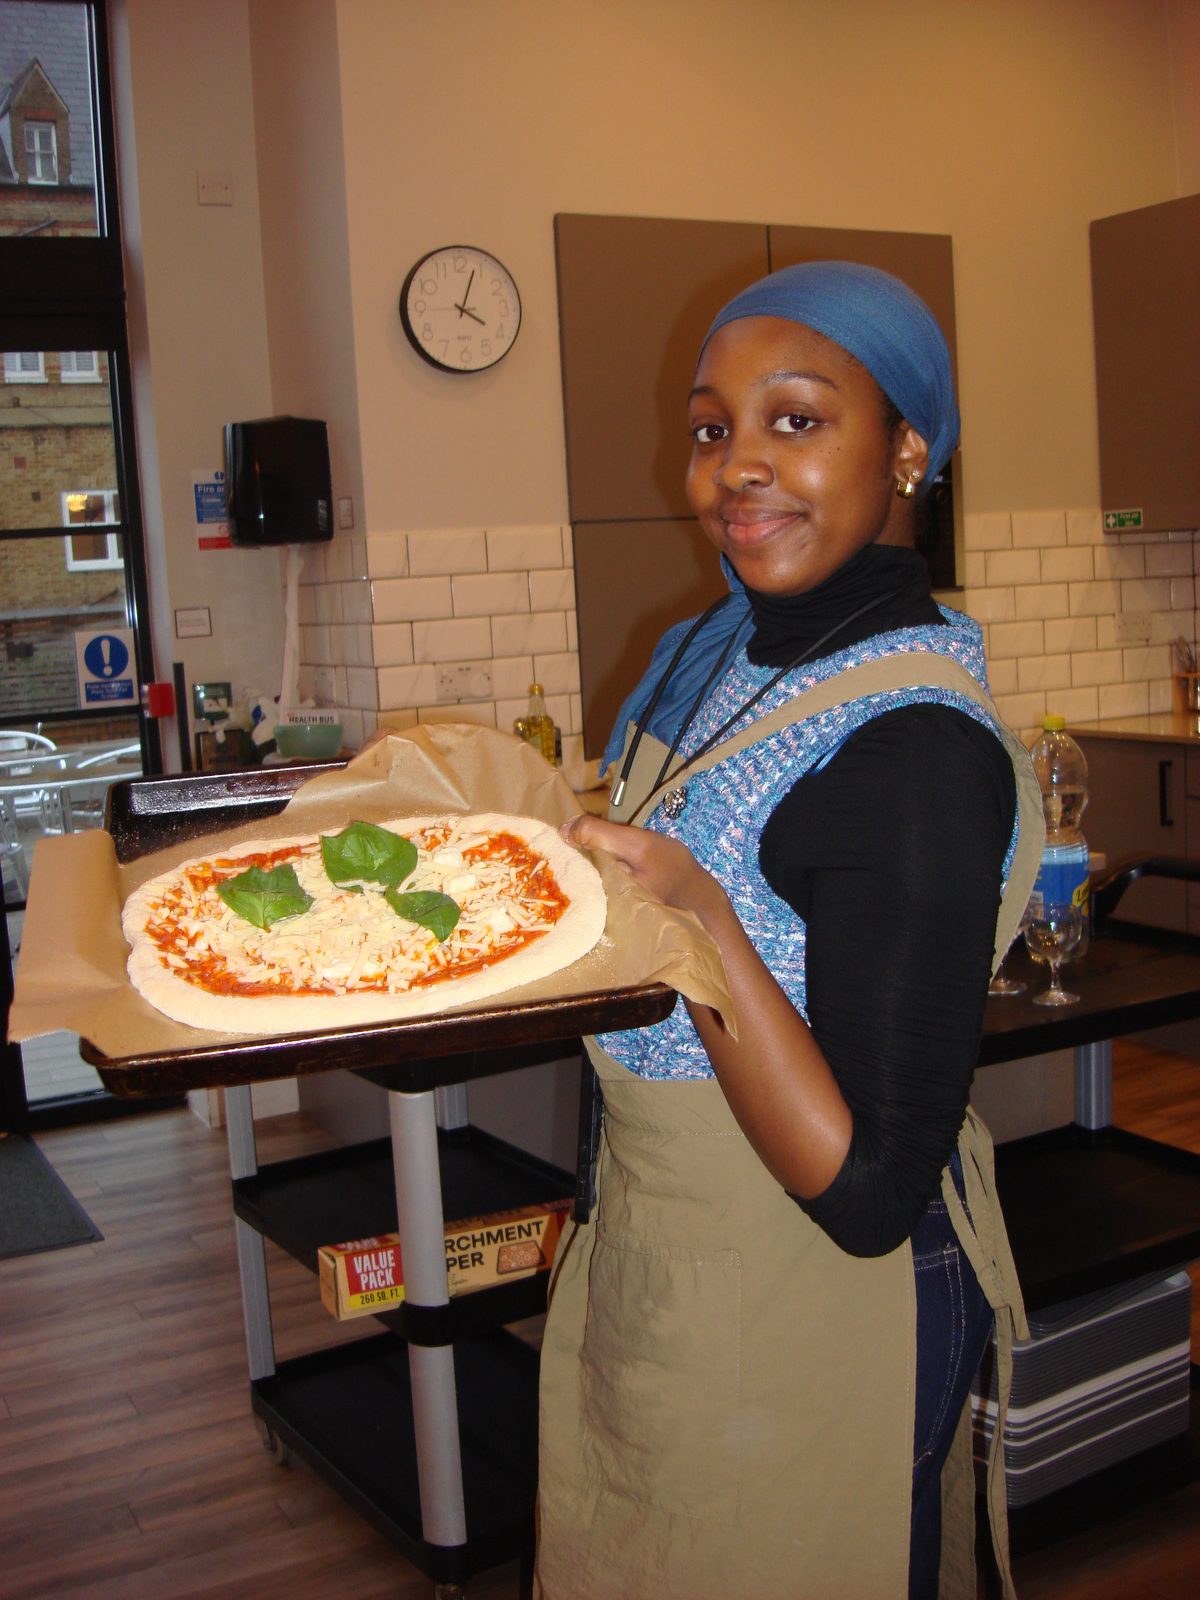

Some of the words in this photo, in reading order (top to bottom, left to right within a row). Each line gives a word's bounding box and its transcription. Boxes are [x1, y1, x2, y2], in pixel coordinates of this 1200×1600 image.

[435, 261, 447, 280] 11
[453, 255, 467, 273] 12
[419, 278, 438, 296] 10
[490, 279, 503, 297] 2
[414, 300, 427, 318] 9
[498, 299, 509, 317] 3
[422, 323, 434, 341] 8
[495, 323, 505, 339] 4
[438, 340, 450, 358] 7
[460, 345, 472, 363] 6
[480, 338, 492, 357] 5
[288, 715, 317, 724] HEALTH
[319, 715, 335, 724] BUS
[444, 1219, 543, 1254] RCHMENT
[353, 1248, 396, 1275] VALUE
[445, 1250, 485, 1273] PER
[359, 1267, 395, 1292] PACK
[359, 1292, 375, 1306] 260
[376, 1290, 389, 1304] SQ.
[390, 1286, 401, 1300] FT.
